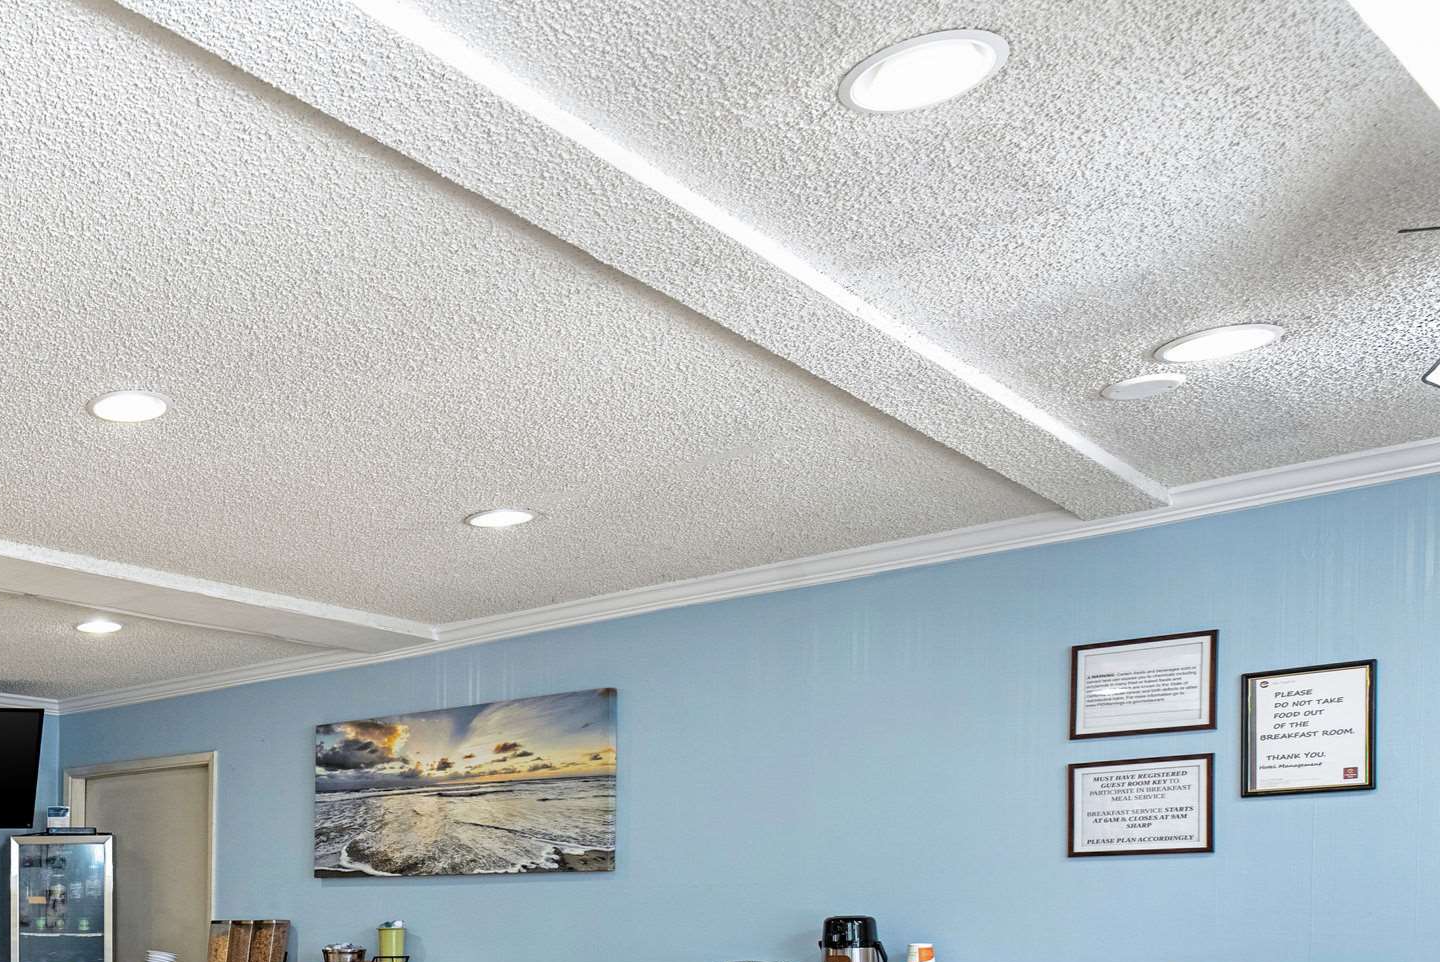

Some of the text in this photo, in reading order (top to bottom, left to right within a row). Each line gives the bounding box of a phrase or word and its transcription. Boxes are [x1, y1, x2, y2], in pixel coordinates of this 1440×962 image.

[1274, 689, 1313, 698] PLEASE
[1274, 696, 1344, 709] DO NOT TAKE
[1273, 708, 1325, 719] FOOD OUT
[1273, 720, 1310, 730] OF THE
[1260, 728, 1355, 741] BREAKFAST ROOM.
[1266, 751, 1326, 761] THANK YOU.
[1138, 770, 1188, 779] REGISTERED
[1089, 788, 1135, 797] PARTICIPATE
[1146, 784, 1192, 793] BREAKFAST
[1087, 809, 1130, 817] BREAKFAST
[1132, 807, 1163, 815] SERVICE
[1138, 834, 1195, 843] ACCORDINGLY
